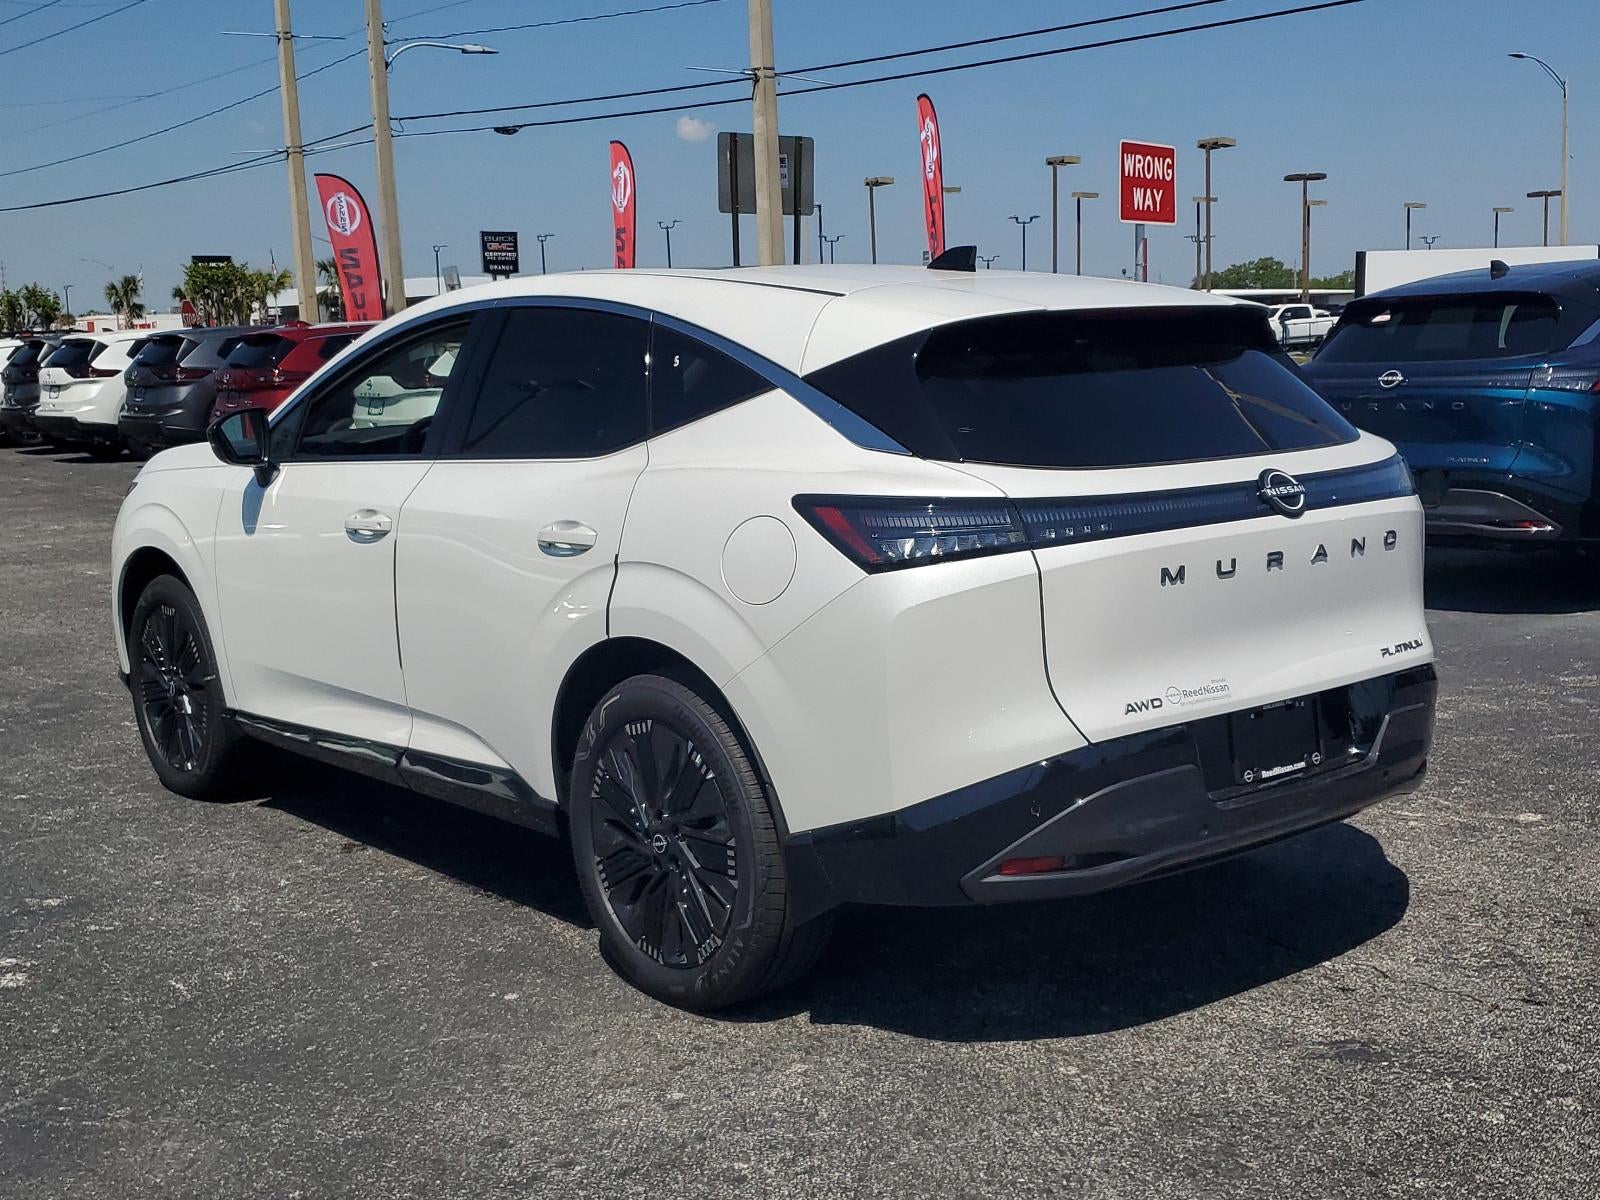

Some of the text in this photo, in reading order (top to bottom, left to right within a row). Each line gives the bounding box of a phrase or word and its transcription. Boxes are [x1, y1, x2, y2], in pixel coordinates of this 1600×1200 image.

[1123, 152, 1173, 182] WRONG
[1132, 186, 1164, 213] WAY
[486, 242, 515, 251] GMC
[182, 313, 197, 327] STOP
[1265, 484, 1306, 496] NISSAN
[1160, 529, 1398, 587] MURANO
[1124, 697, 1163, 716] AWD
